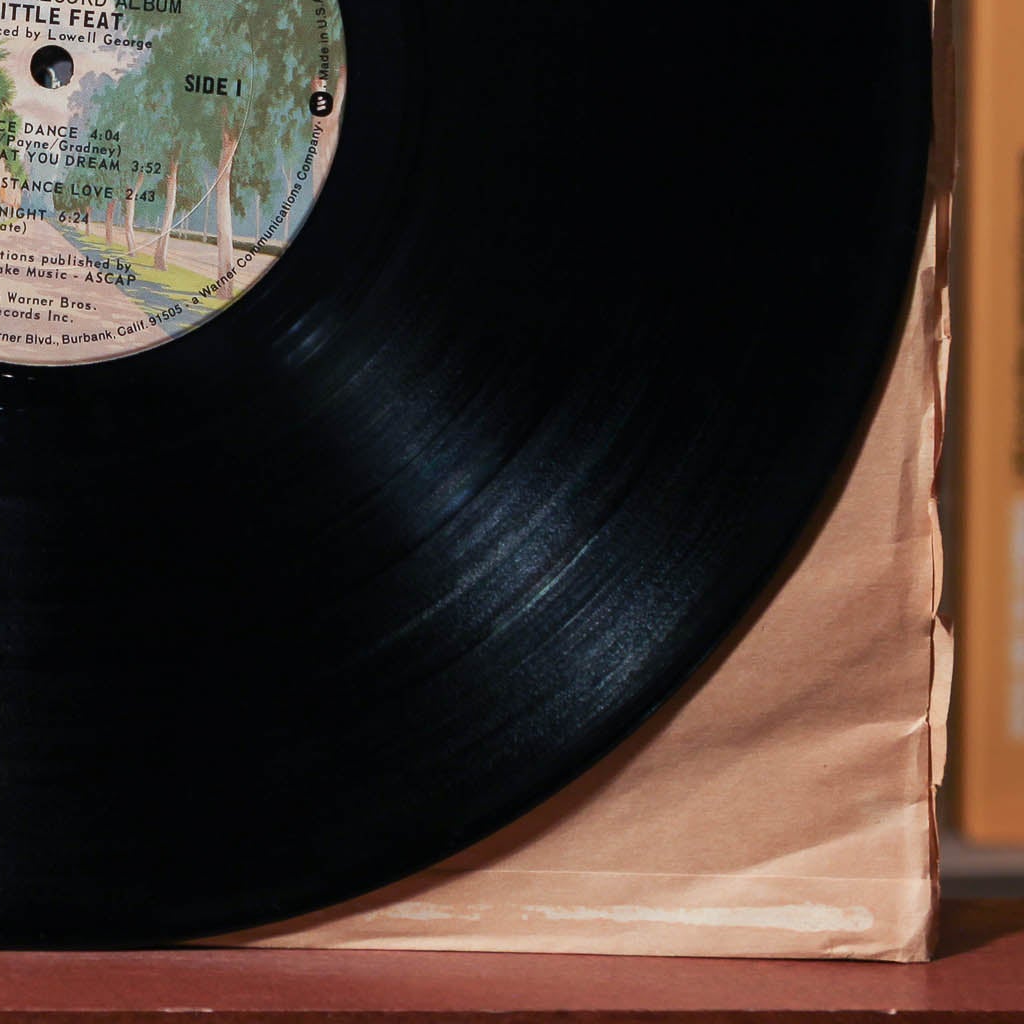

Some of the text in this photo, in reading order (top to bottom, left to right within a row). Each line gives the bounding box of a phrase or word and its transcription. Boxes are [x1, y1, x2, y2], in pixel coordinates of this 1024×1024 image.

[69, 9, 124, 30] FEAT
[26, 27, 41, 41] by
[48, 29, 96, 43] Lowell
[104, 34, 153, 51] George
[319, 32, 329, 45] in
[318, 50, 329, 82] Made
[184, 74, 228, 95] SIDE
[24, 123, 78, 138] DANCE
[89, 129, 120, 142] 4:04
[27, 151, 59, 165] YOU
[65, 155, 120, 171] DREAM
[131, 160, 162, 174] 3:52
[71, 183, 113, 199] LOVE
[125, 188, 156, 202] 2:43
[58, 210, 89, 224] 6:24
[41, 254, 110, 269] published
[116, 260, 132, 273] by
[62, 330, 116, 344] Burbank,
[117, 319, 149, 337] Calif.
[149, 304, 183, 326] 91505
[191, 296, 200, 305] a
[199, 267, 237, 298] Warner
[236, 183, 302, 268] Communications
[26, 267, 67, 280] Music
[84, 272, 136, 286] ASCAP
[7, 292, 54, 307] Warner
[60, 297, 97, 311] Bros.
[48, 310, 74, 323] Inc.
